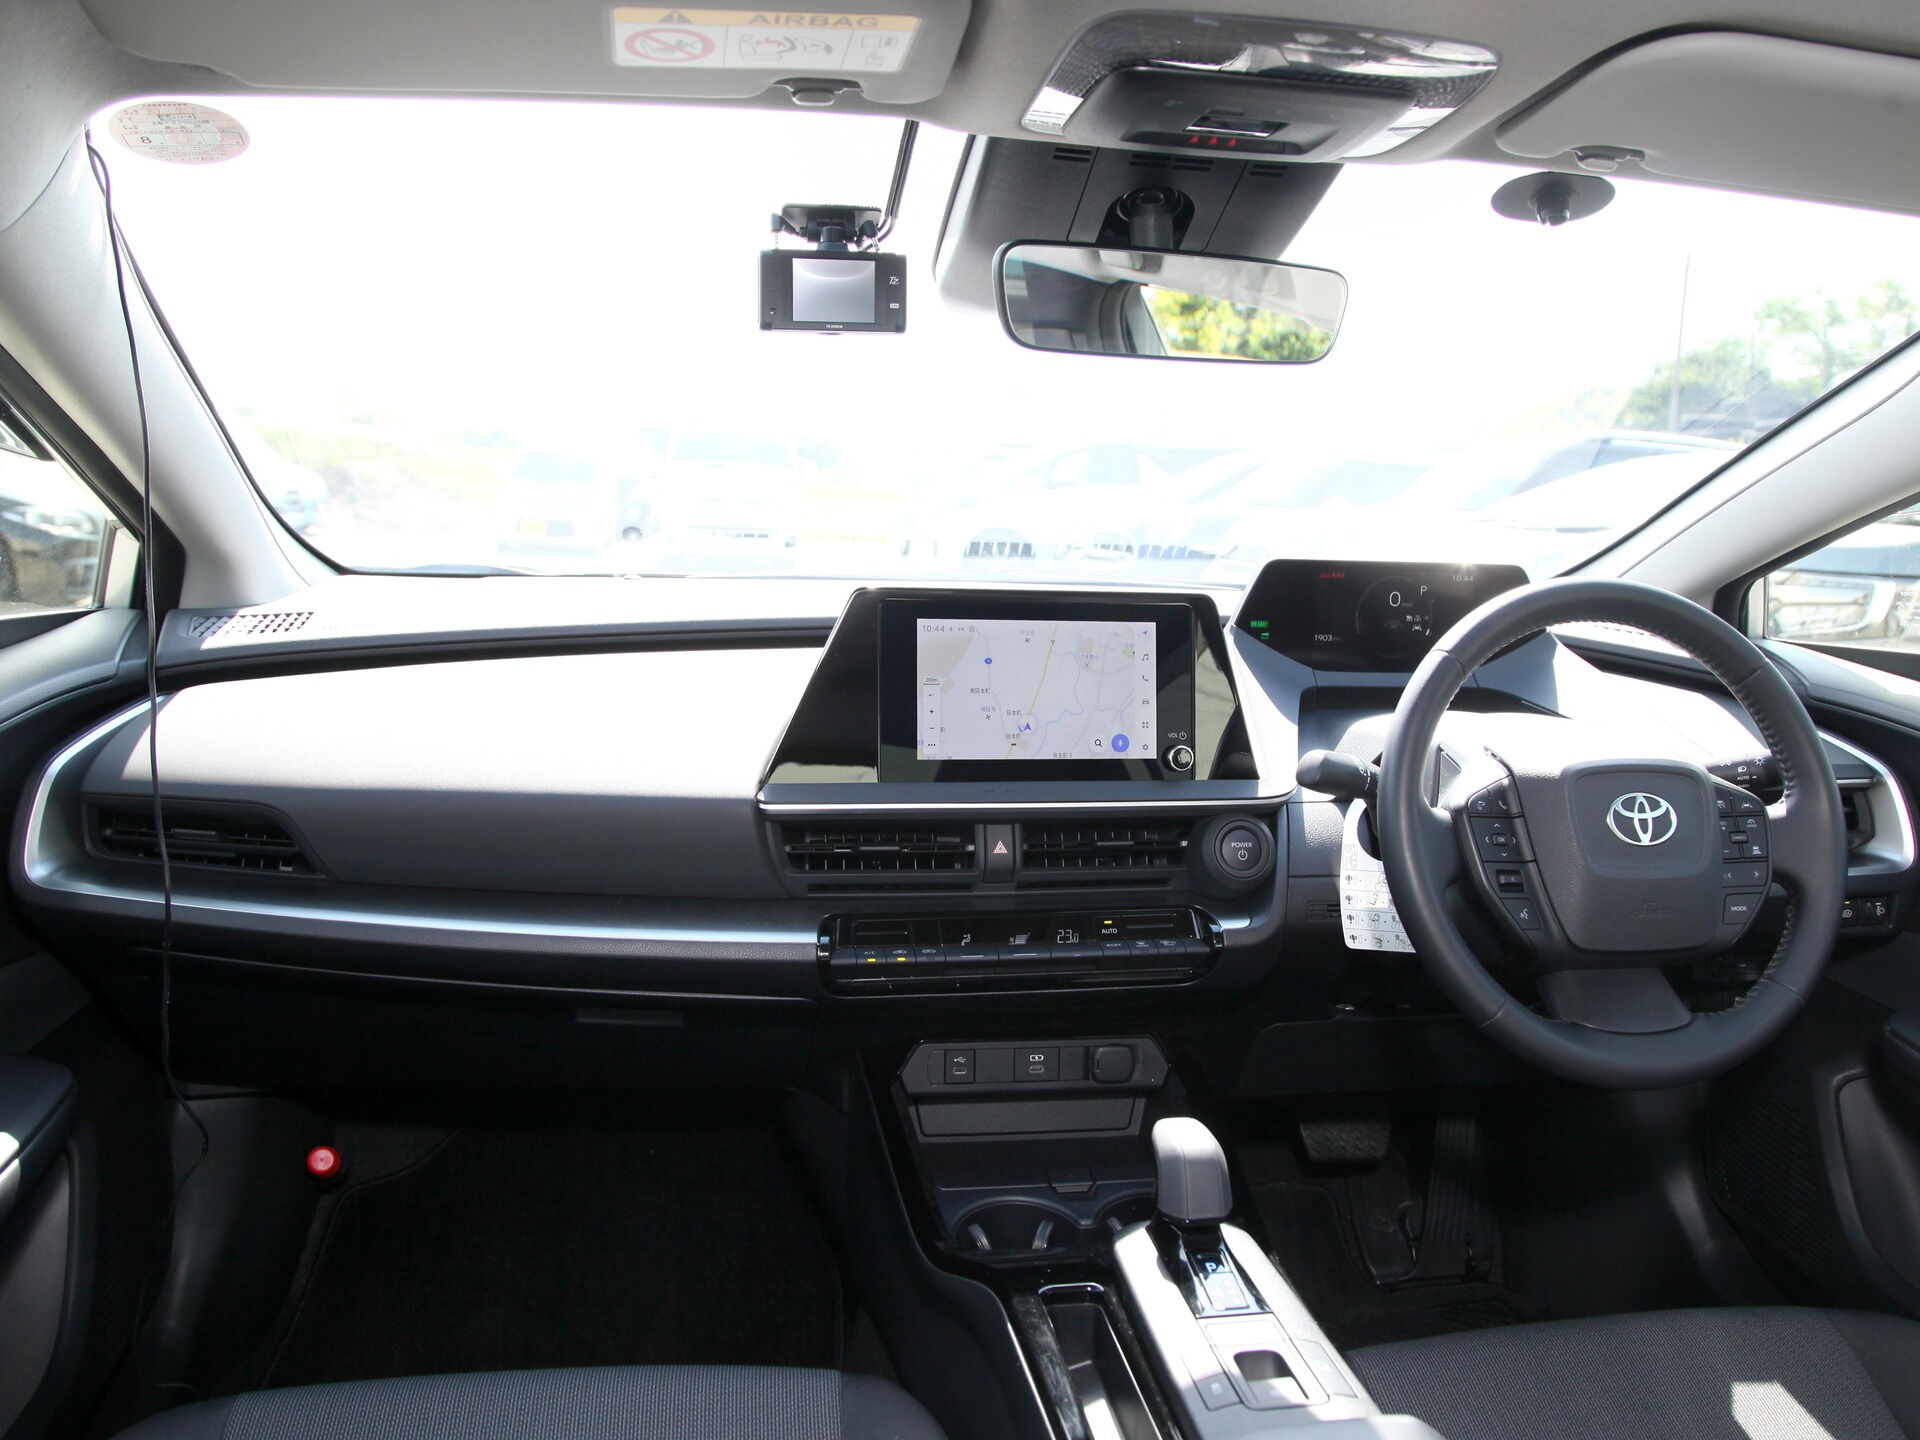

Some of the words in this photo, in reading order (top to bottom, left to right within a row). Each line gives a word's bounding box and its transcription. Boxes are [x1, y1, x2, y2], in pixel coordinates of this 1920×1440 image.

[749, 13, 879, 28] AIRBAG
[1420, 585, 1428, 595] P
[1389, 591, 1401, 607] 0
[922, 625, 945, 633] 10:44
[1314, 633, 1333, 642] 1903
[1057, 929, 1079, 943] 23.0
[1205, 1261, 1217, 1273] P
